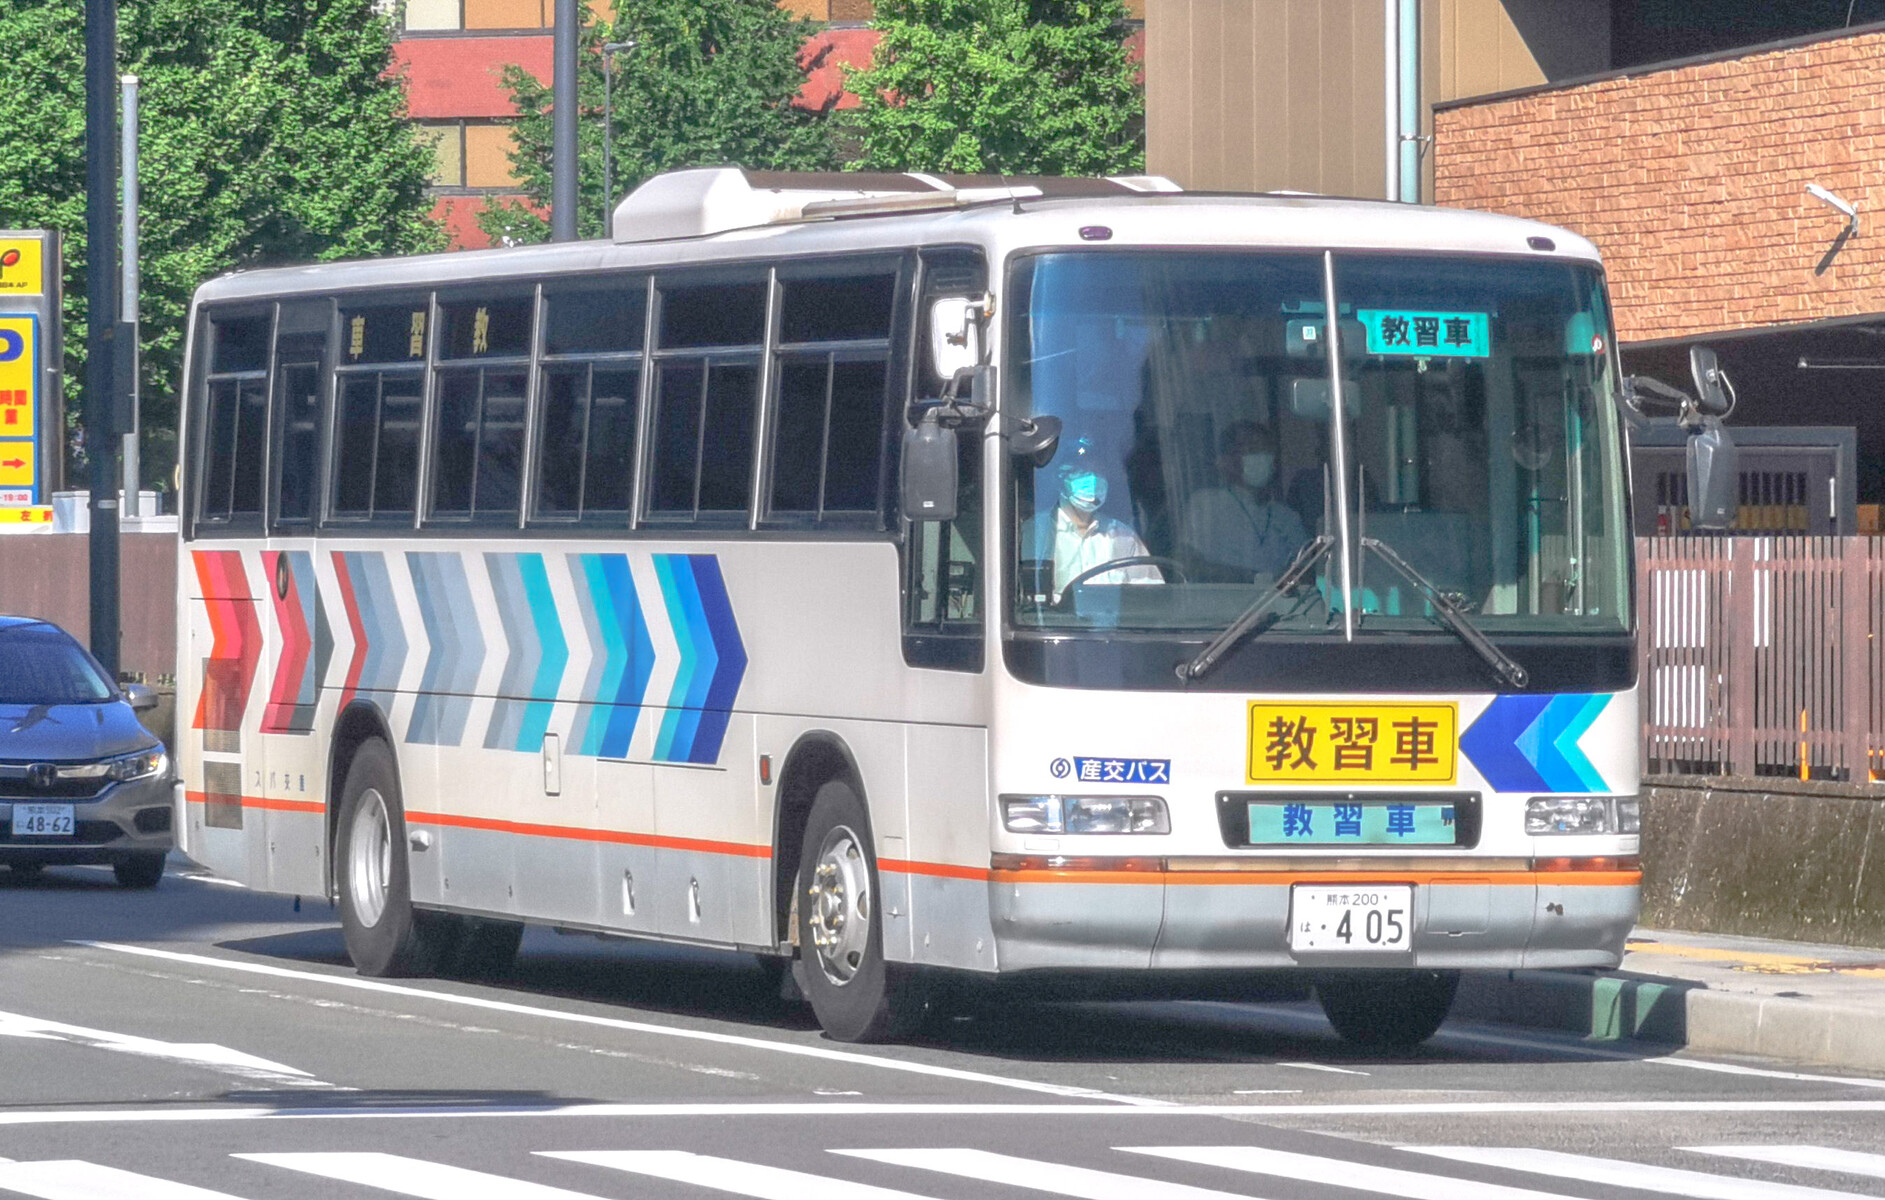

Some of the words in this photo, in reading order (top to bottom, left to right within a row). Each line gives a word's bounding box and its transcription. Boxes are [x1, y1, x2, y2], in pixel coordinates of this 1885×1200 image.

[1381, 315, 1472, 348] 教習車
[1265, 715, 1439, 771] 教習車
[1080, 759, 1168, 782] 産交バス
[26, 816, 71, 832] 48-62
[1282, 803, 1416, 837] 教習車
